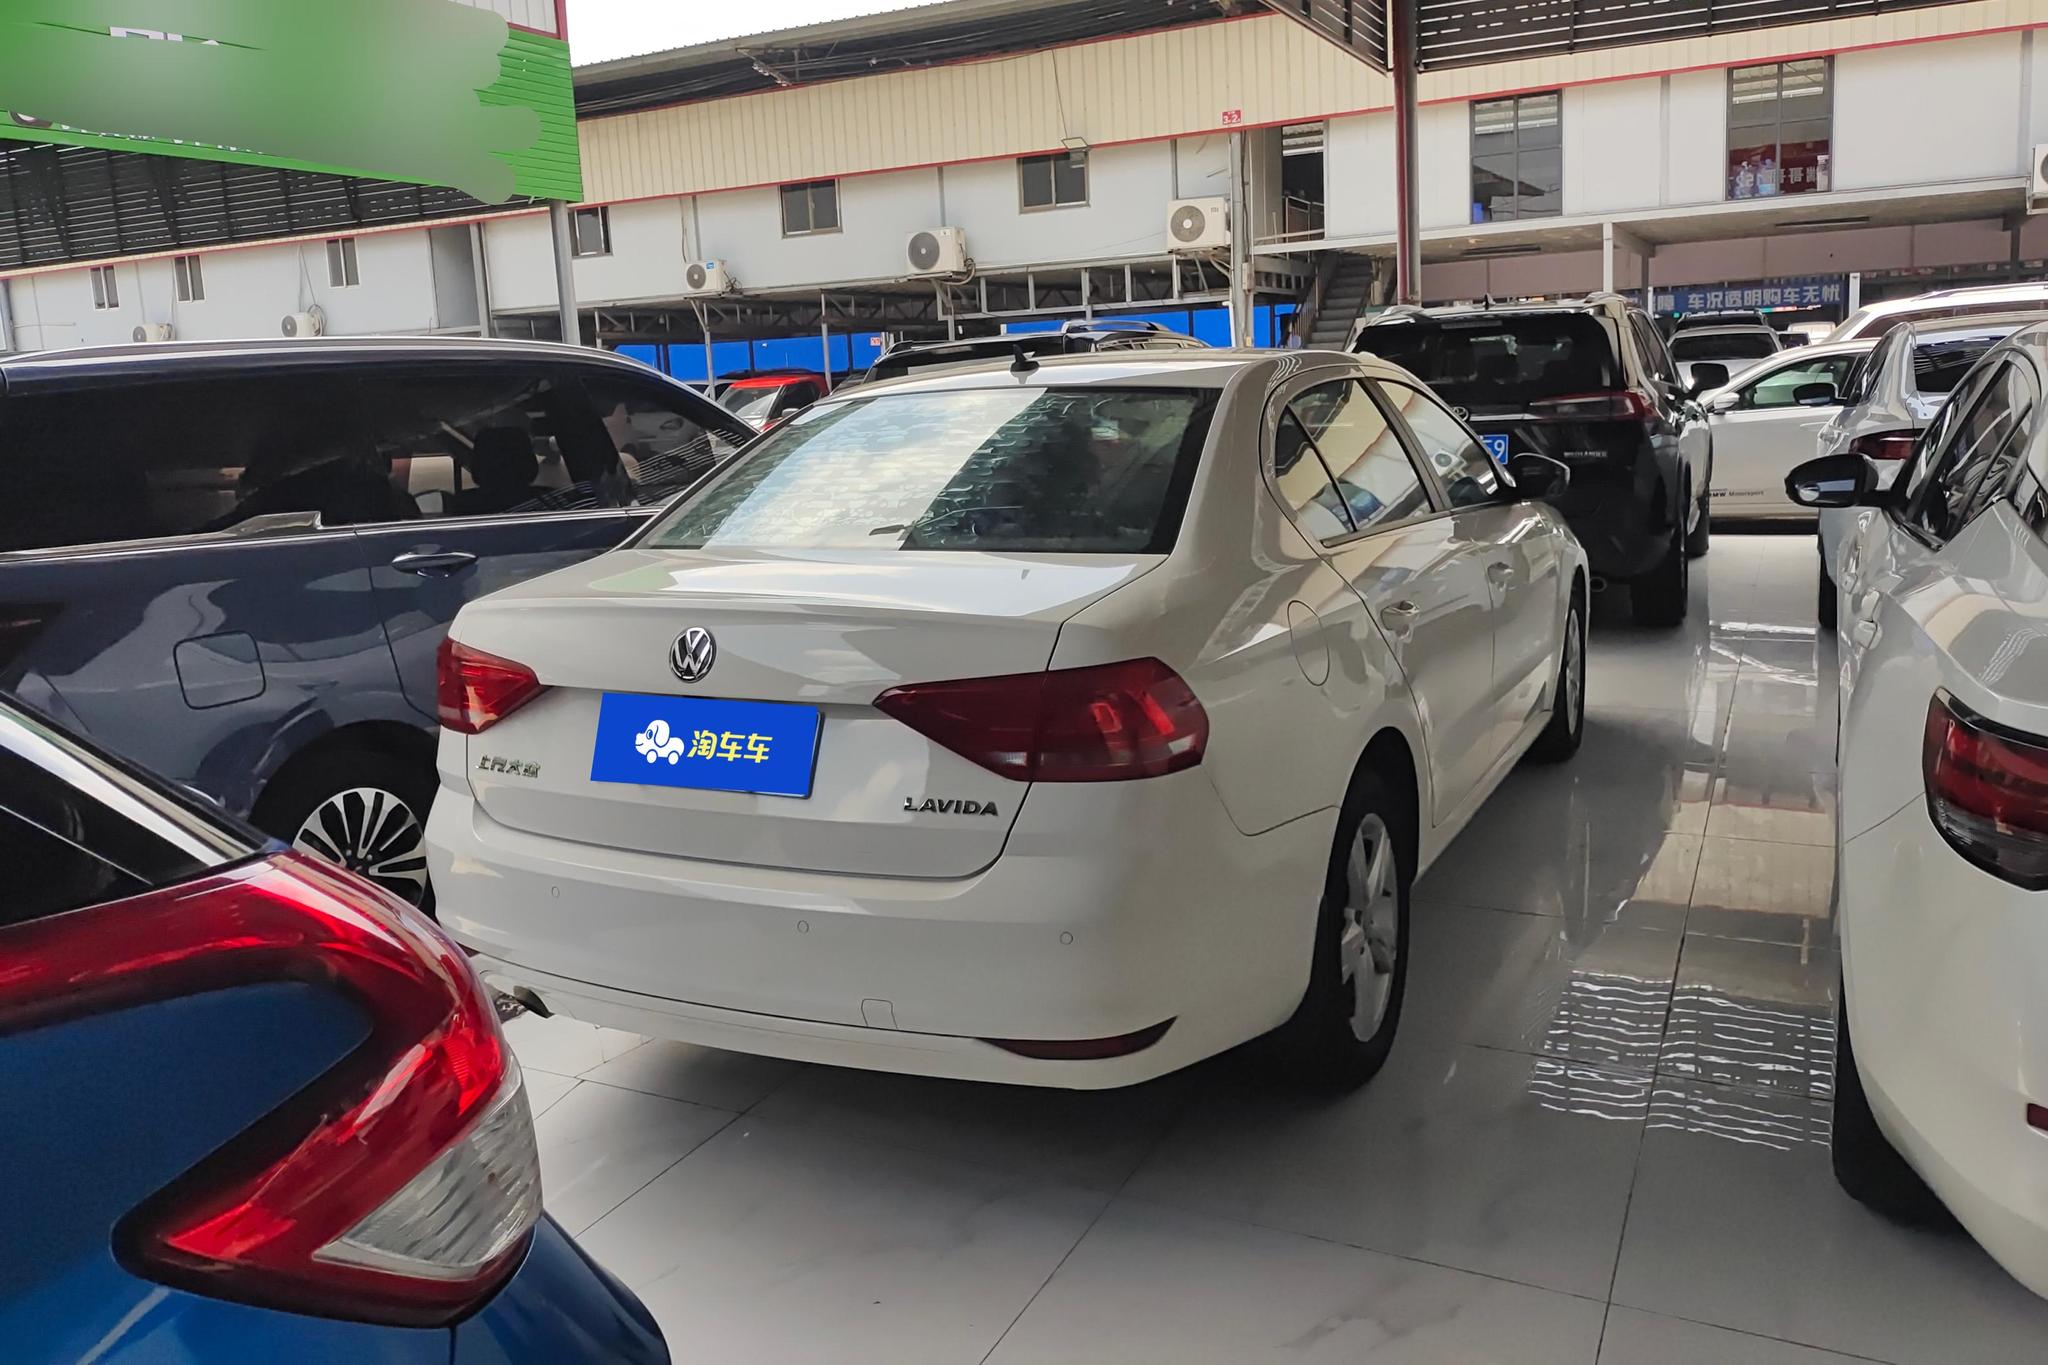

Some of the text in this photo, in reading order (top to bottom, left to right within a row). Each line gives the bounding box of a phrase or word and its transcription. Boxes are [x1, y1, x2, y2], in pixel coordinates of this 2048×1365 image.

[1687, 284, 1841, 310] 车况透明购车无忧
[903, 796, 999, 817] LAVIDA
